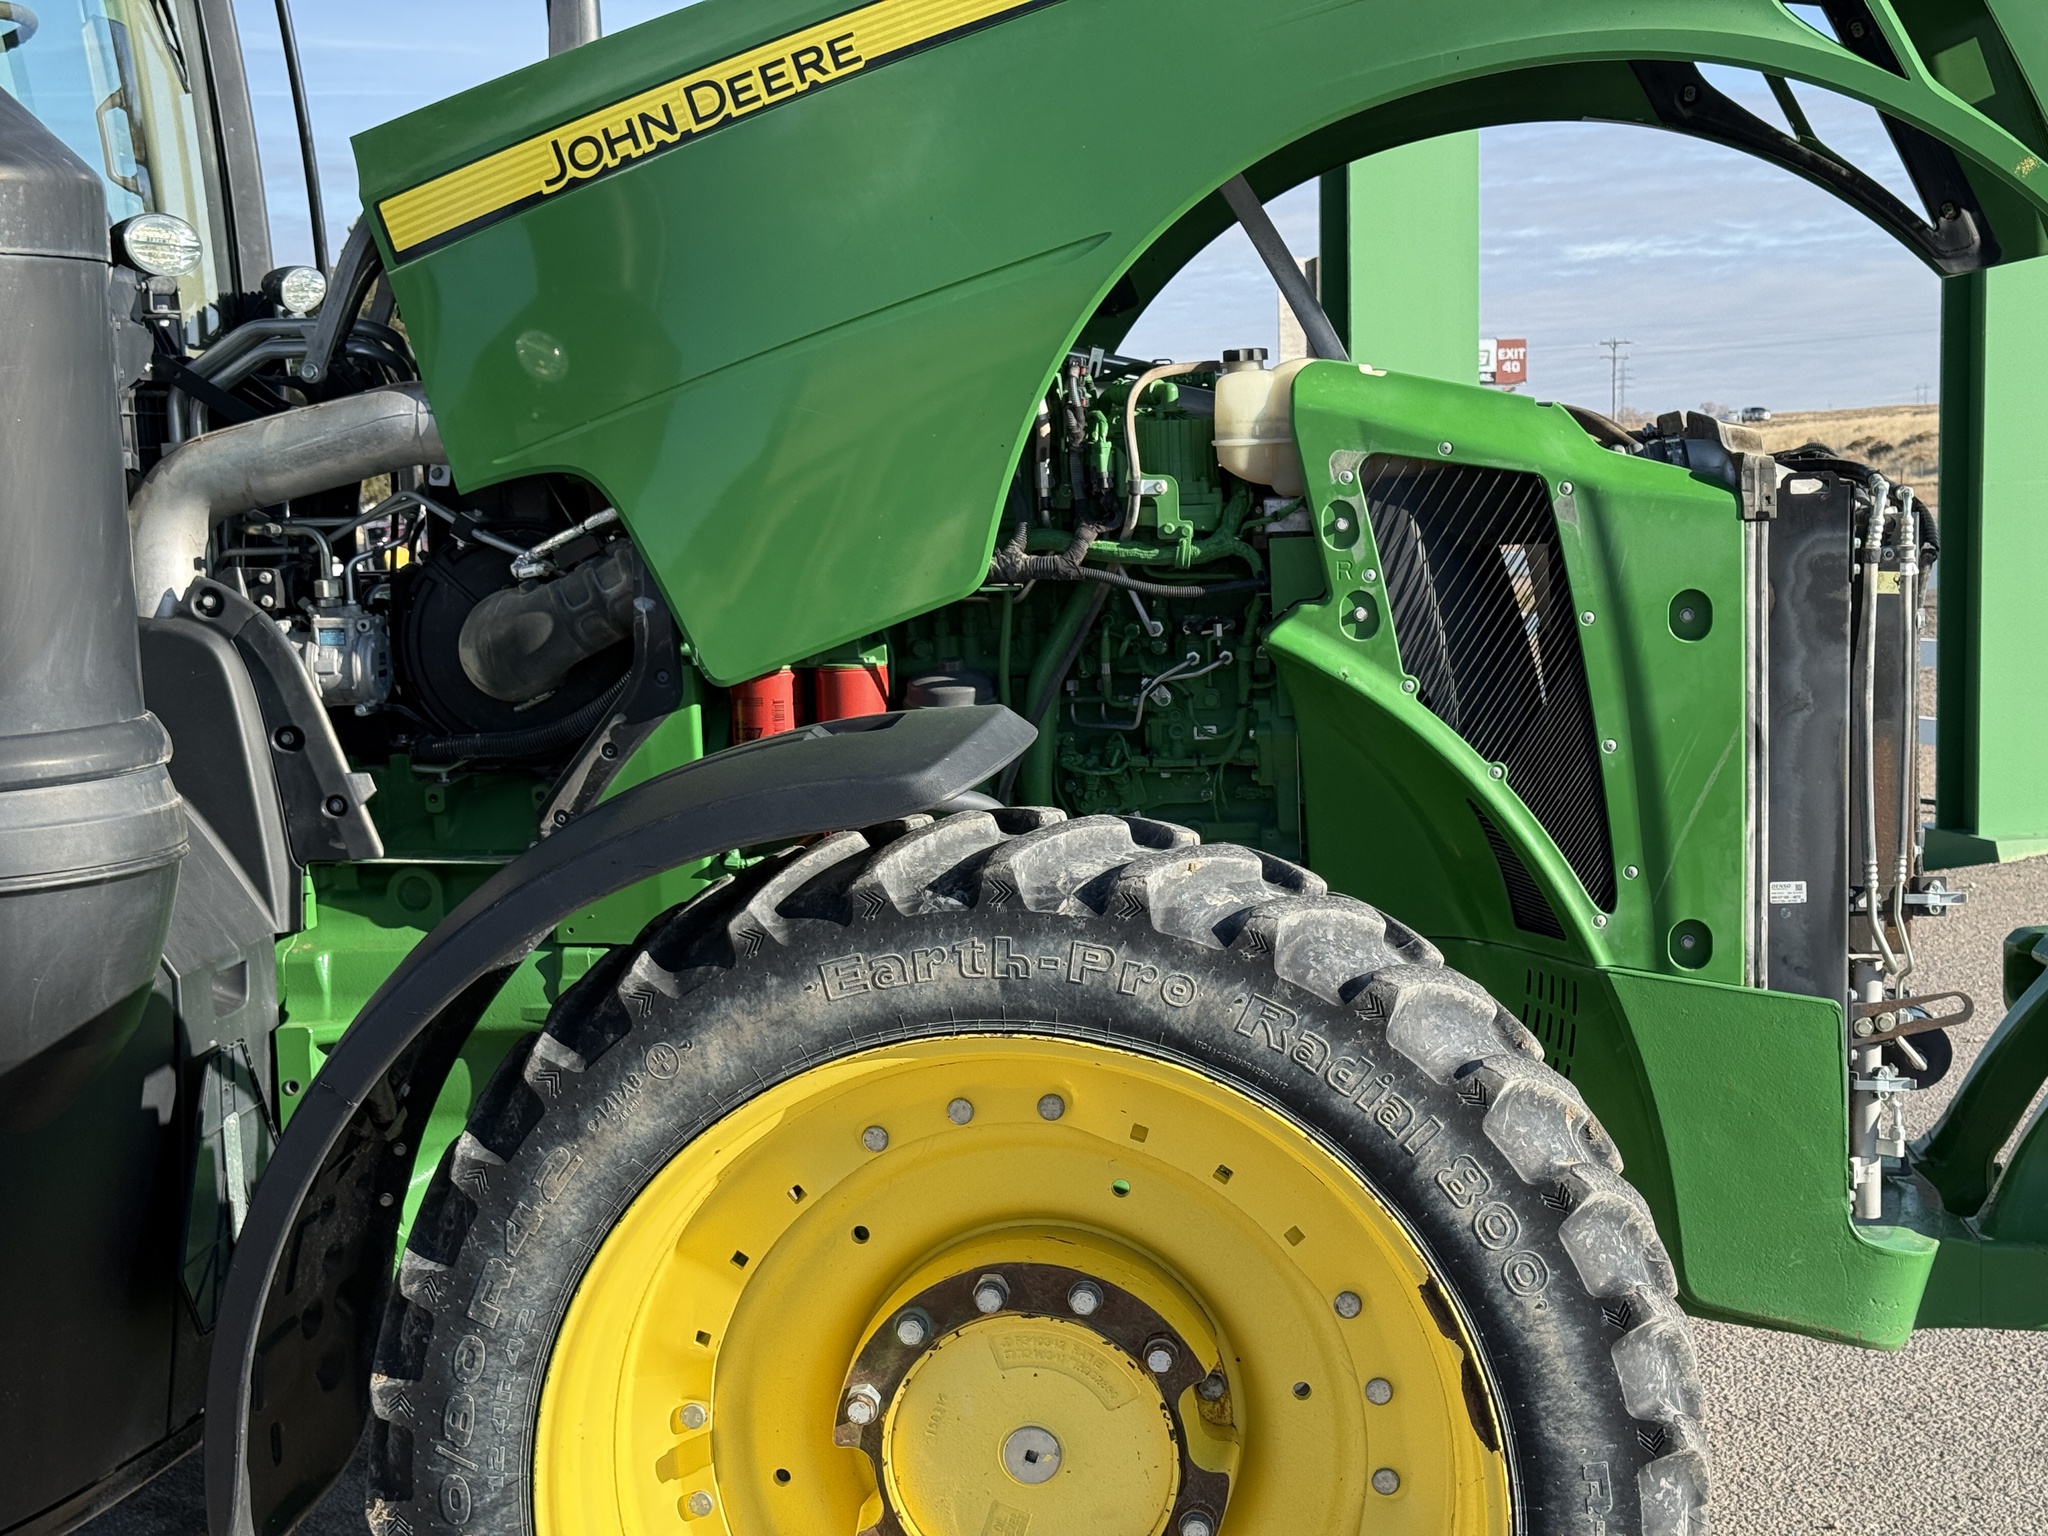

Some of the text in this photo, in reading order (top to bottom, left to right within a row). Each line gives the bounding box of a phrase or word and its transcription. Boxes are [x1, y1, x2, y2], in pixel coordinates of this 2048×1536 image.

[543, 31, 864, 188] JOHN DEERE
[1498, 347, 1526, 360] EXIT
[1502, 360, 1521, 373] 40
[1336, 560, 1354, 581] R
[817, 935, 1550, 1298] Earth-Pro Radial 800
[435, 1147, 584, 1536] 0/80R42
